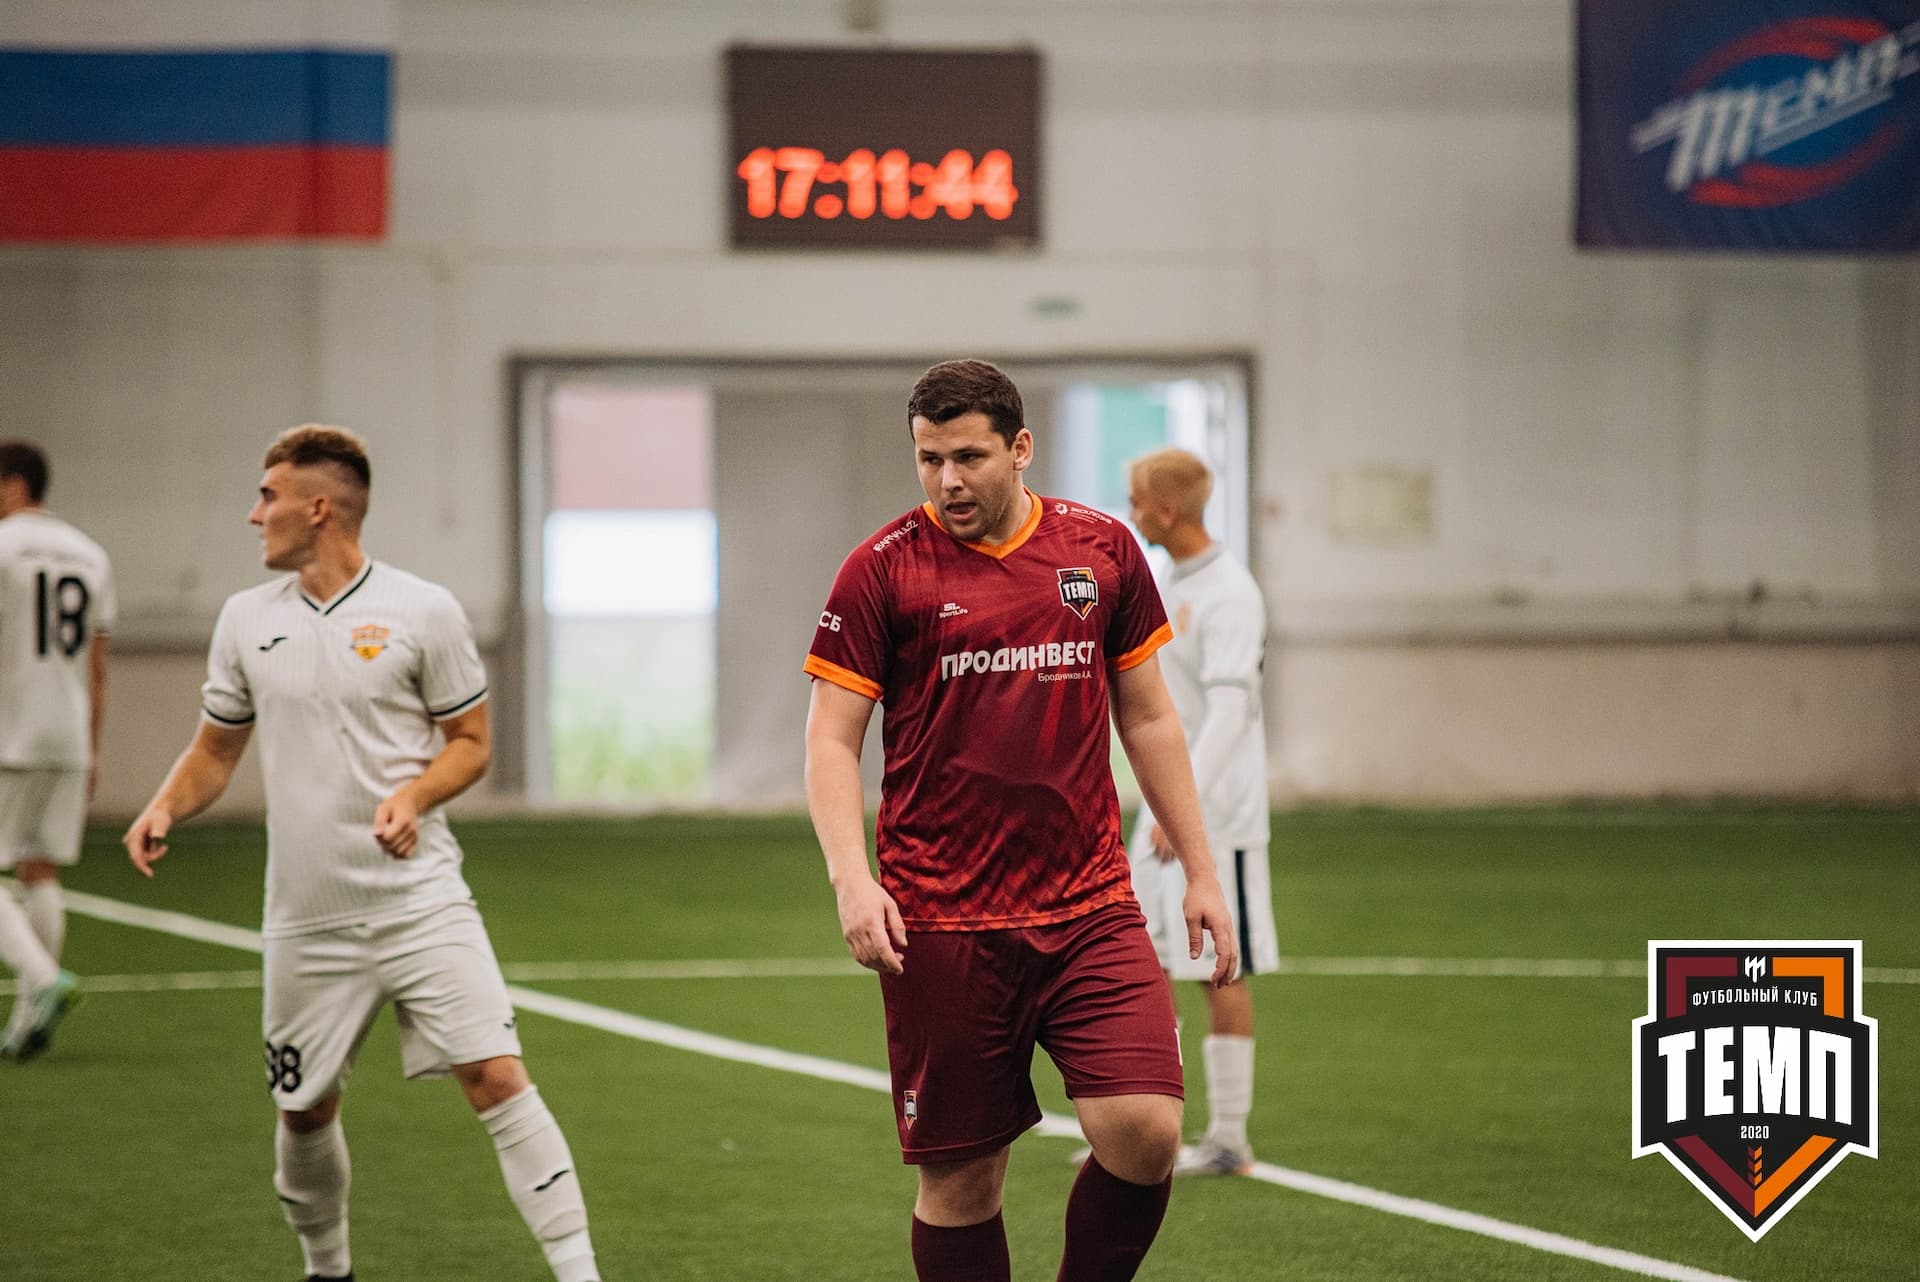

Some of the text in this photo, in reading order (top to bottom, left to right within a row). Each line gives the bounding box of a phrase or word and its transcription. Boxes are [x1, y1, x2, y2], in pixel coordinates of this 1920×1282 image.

[738, 147, 1019, 220] 17:11:44
[36, 570, 90, 657] 18
[1062, 581, 1096, 601] ТЕМП
[941, 640, 1096, 682] ПРОДИНВЕСТ
